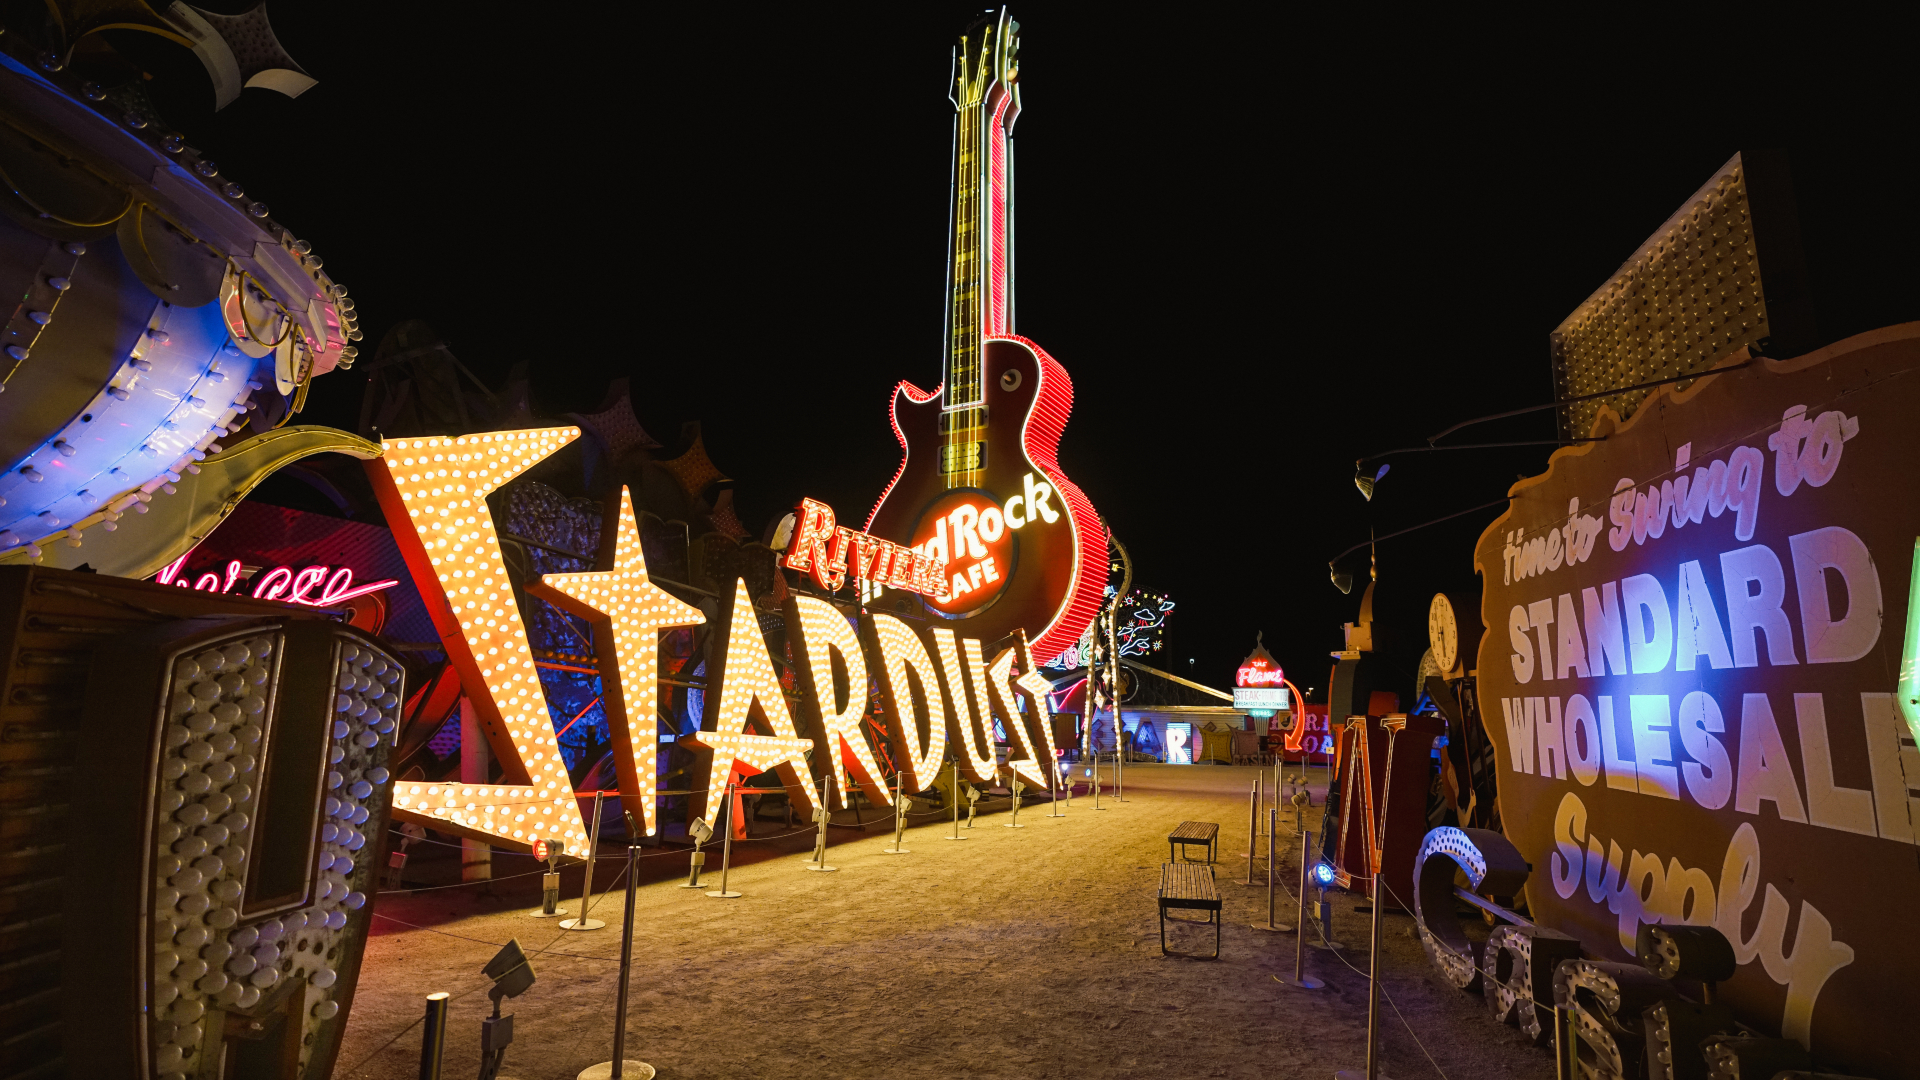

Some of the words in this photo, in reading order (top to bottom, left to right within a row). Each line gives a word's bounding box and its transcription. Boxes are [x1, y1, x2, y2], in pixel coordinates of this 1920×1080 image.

[786, 496, 949, 597] RIVIERA
[949, 472, 1060, 560] Rock
[1502, 527, 1565, 586] time
[1561, 497, 1603, 566] to
[1608, 442, 1764, 553] Swing
[1768, 405, 1859, 497] to
[381, 425, 1064, 861] STARDUST
[1239, 667, 1282, 686] Flame
[1508, 525, 1883, 684] STANDARD
[1550, 791, 1855, 1052] Supply
